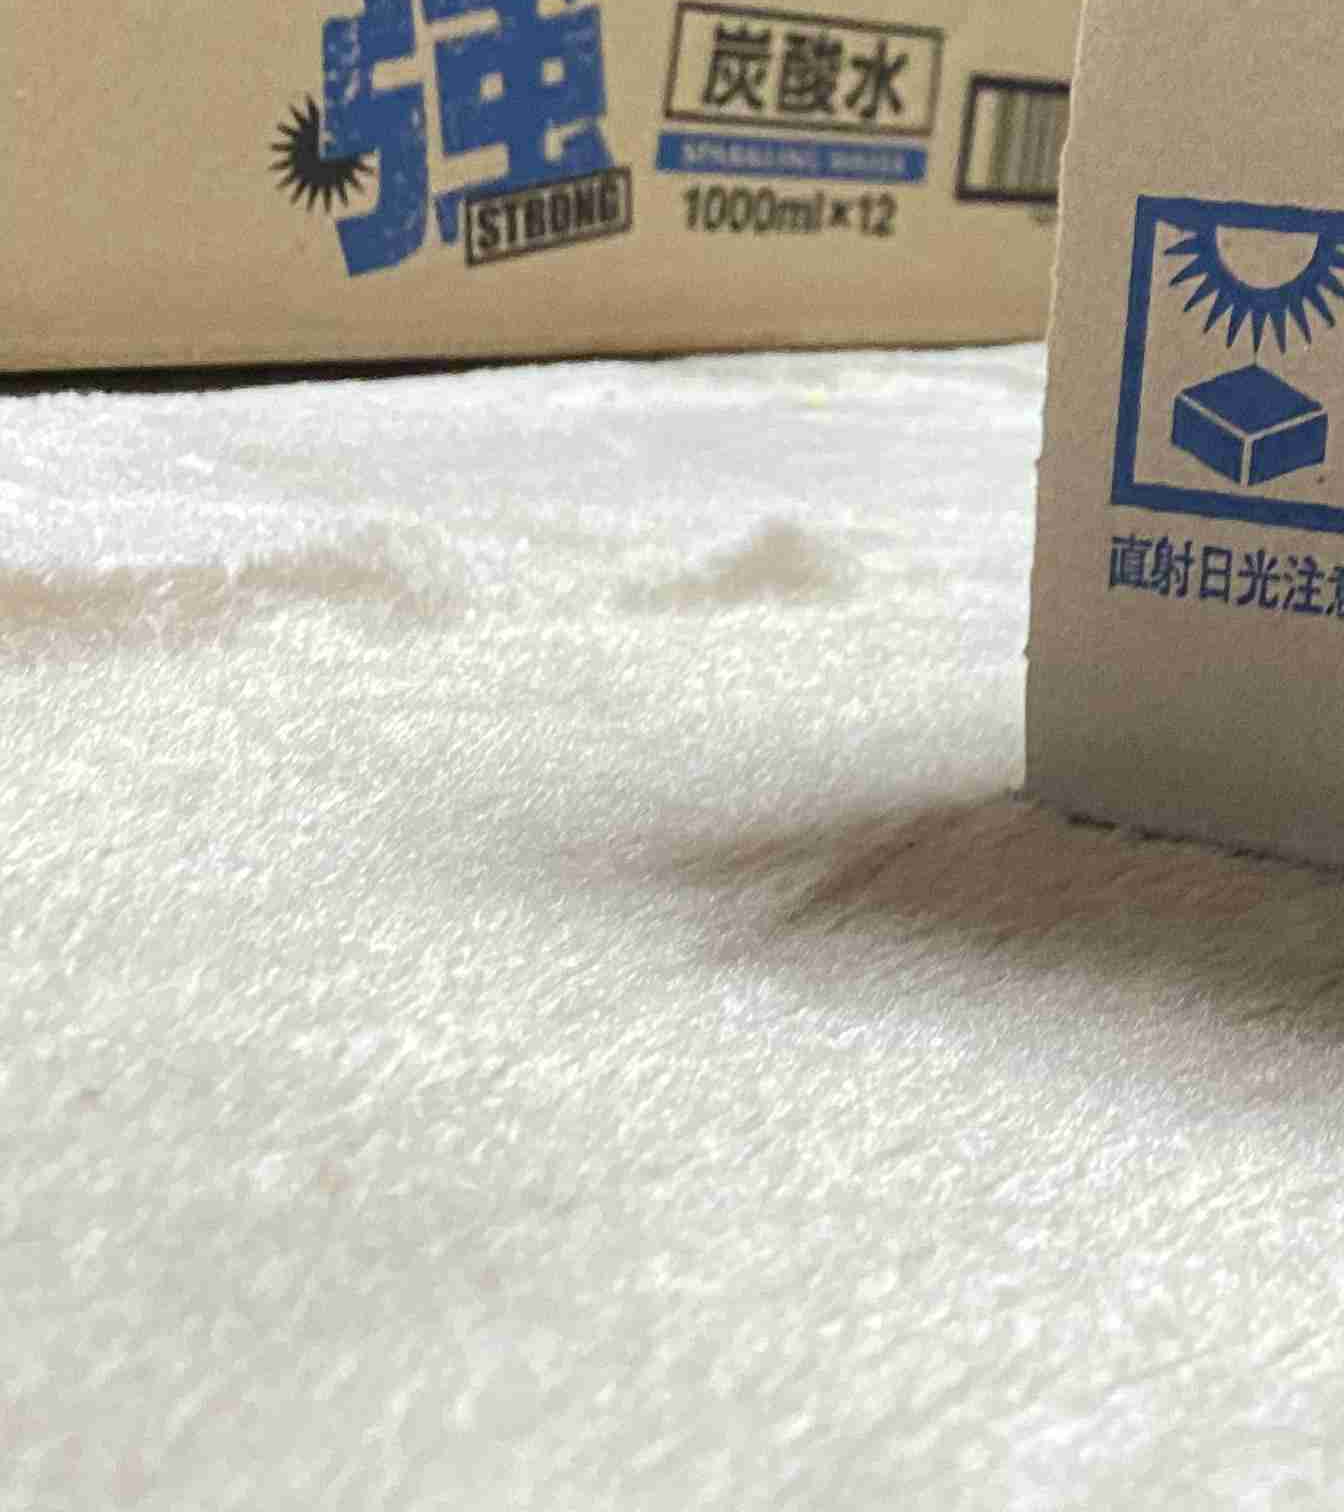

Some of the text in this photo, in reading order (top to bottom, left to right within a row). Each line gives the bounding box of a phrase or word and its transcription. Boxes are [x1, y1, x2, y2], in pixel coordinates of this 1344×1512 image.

[703, 22, 909, 118] 炭酸水
[476, 180, 621, 252] STRONG
